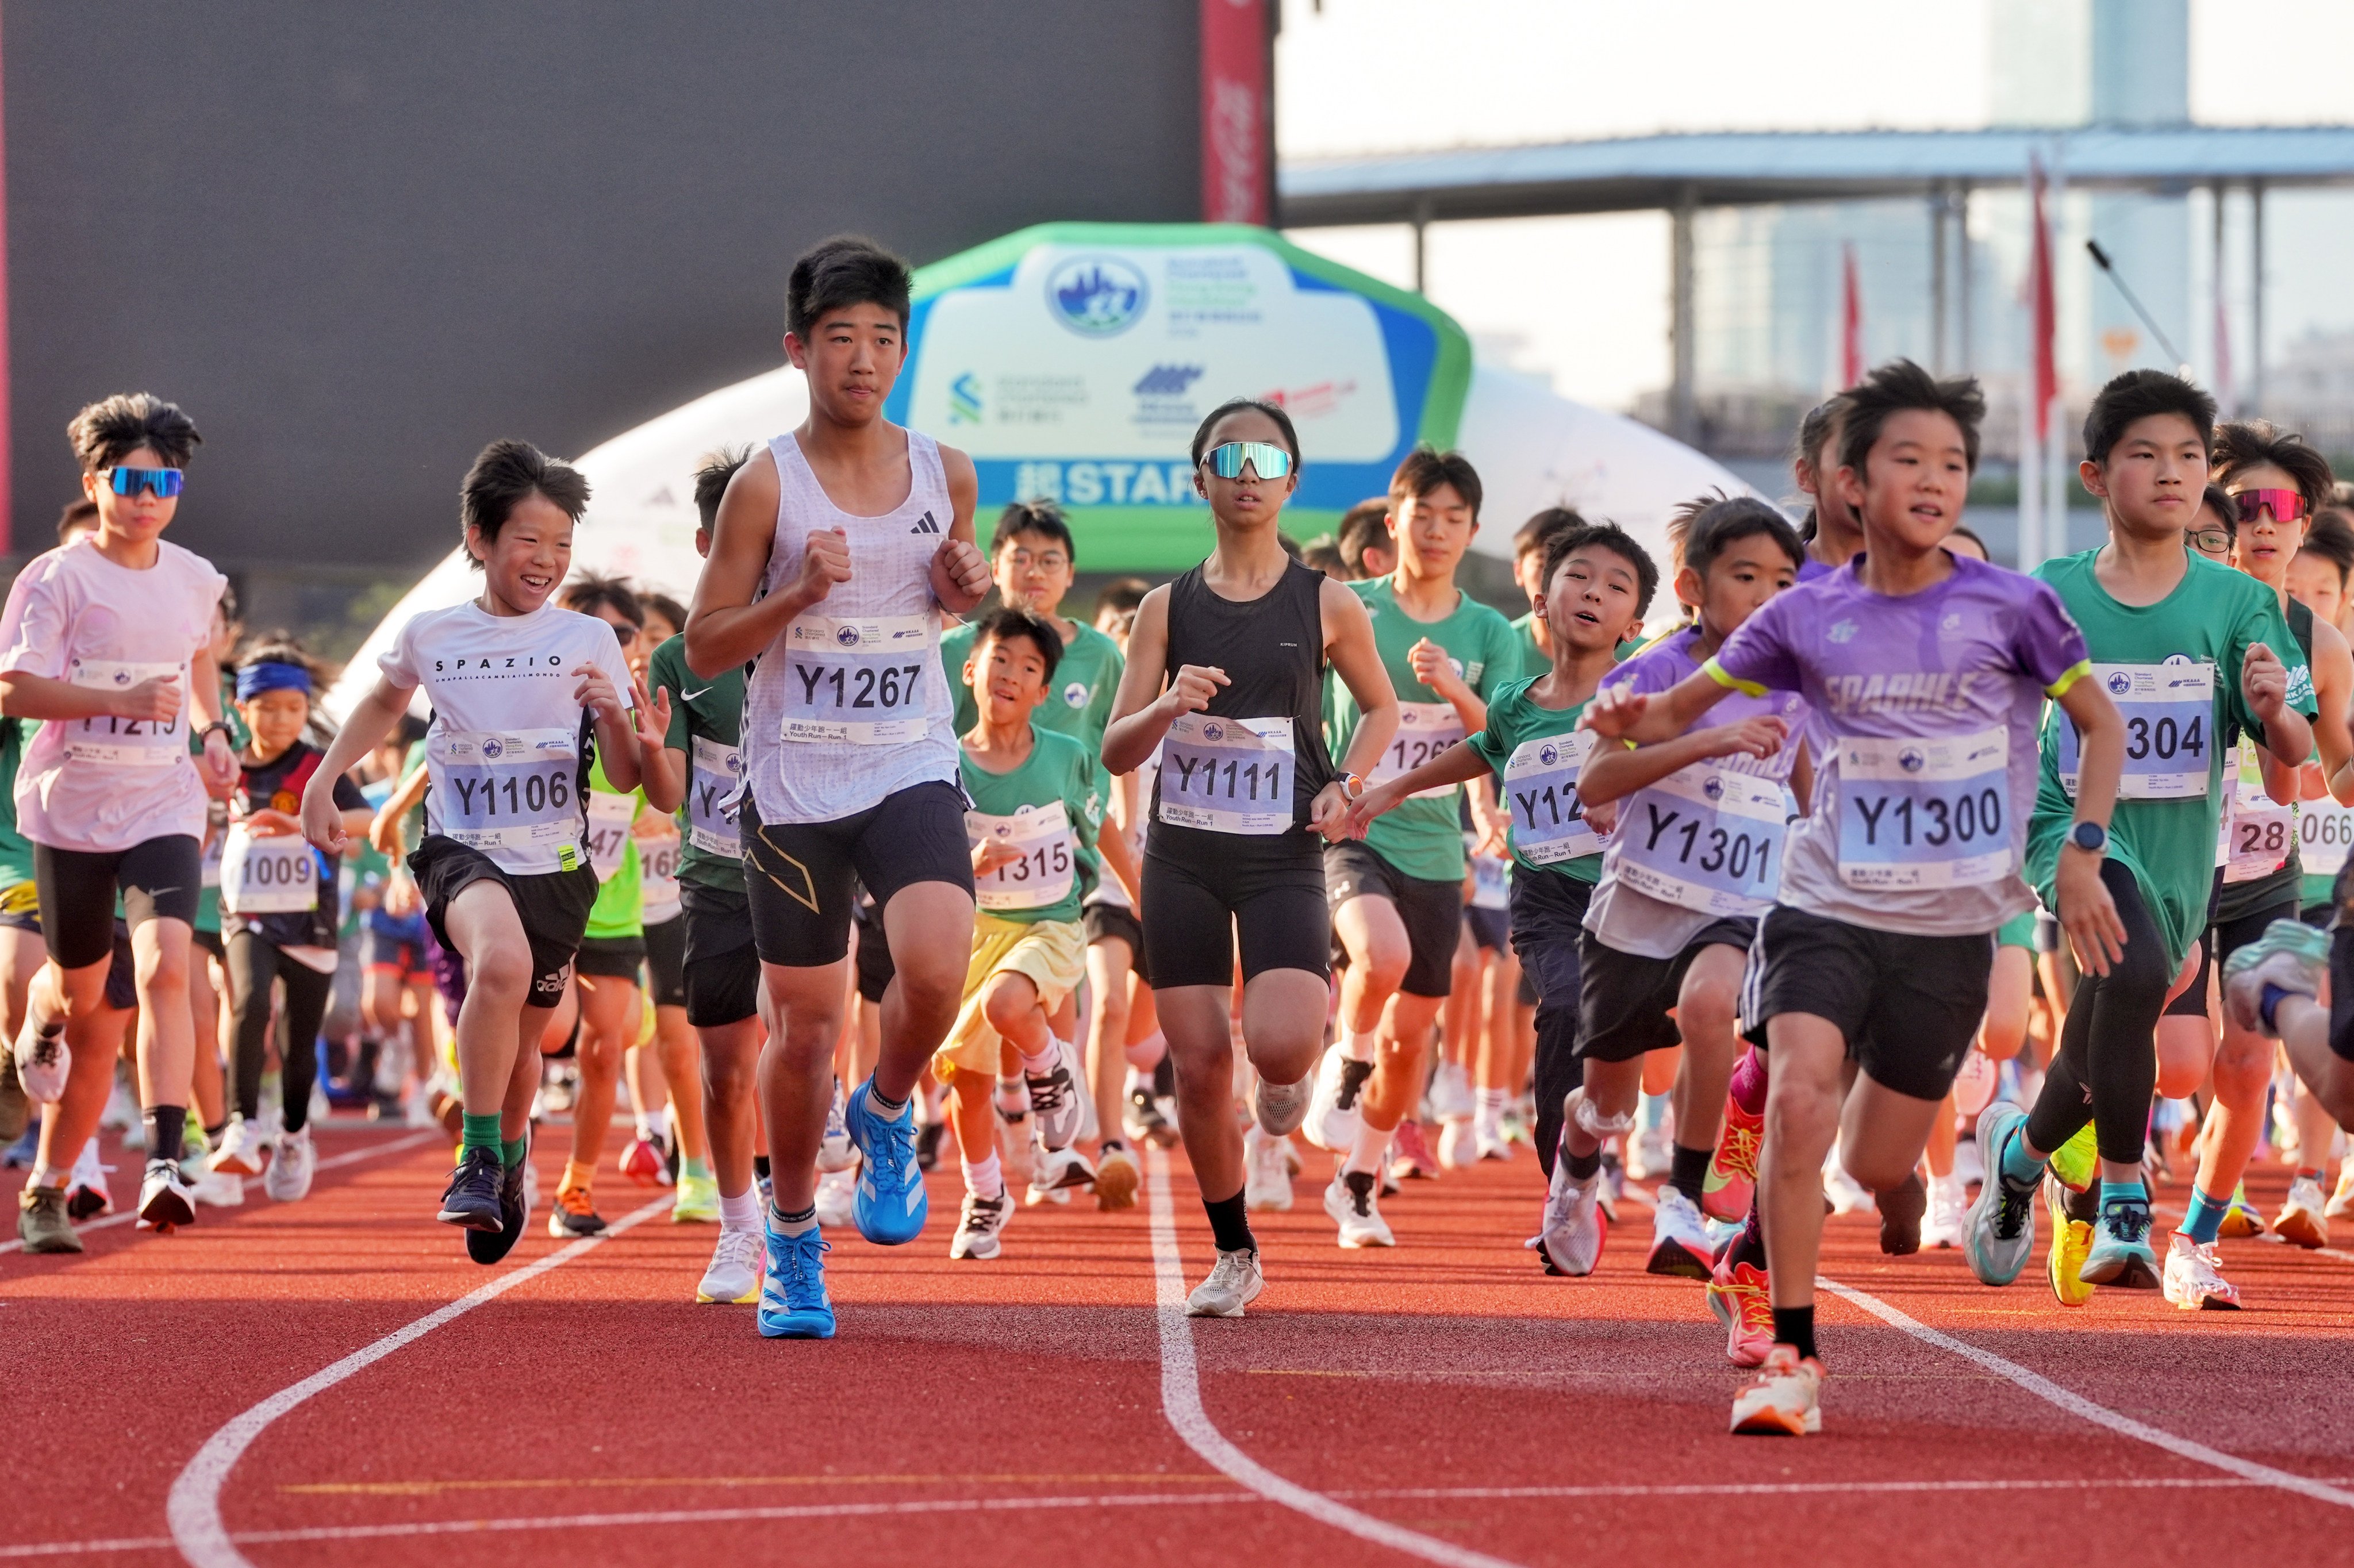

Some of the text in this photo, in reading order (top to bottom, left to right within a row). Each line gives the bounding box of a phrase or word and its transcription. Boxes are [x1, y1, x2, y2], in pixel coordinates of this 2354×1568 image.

[436, 655, 561, 672] SPAZIO
[795, 664, 921, 708] Y1267
[1376, 739, 1459, 769] 126
[2070, 713, 2204, 760] 304
[454, 771, 569, 816] Y1106
[1173, 753, 1280, 800] Y1111
[1166, 814, 1181, 822] Youth
[1515, 781, 1583, 830] Y12
[1854, 787, 2000, 847] Y1300
[697, 837, 708, 847] Youth
[720, 846, 731, 854] Run
[1646, 802, 1771, 883] Y1301
[2240, 821, 2284, 853] 28
[2302, 813, 2352, 846] 066
